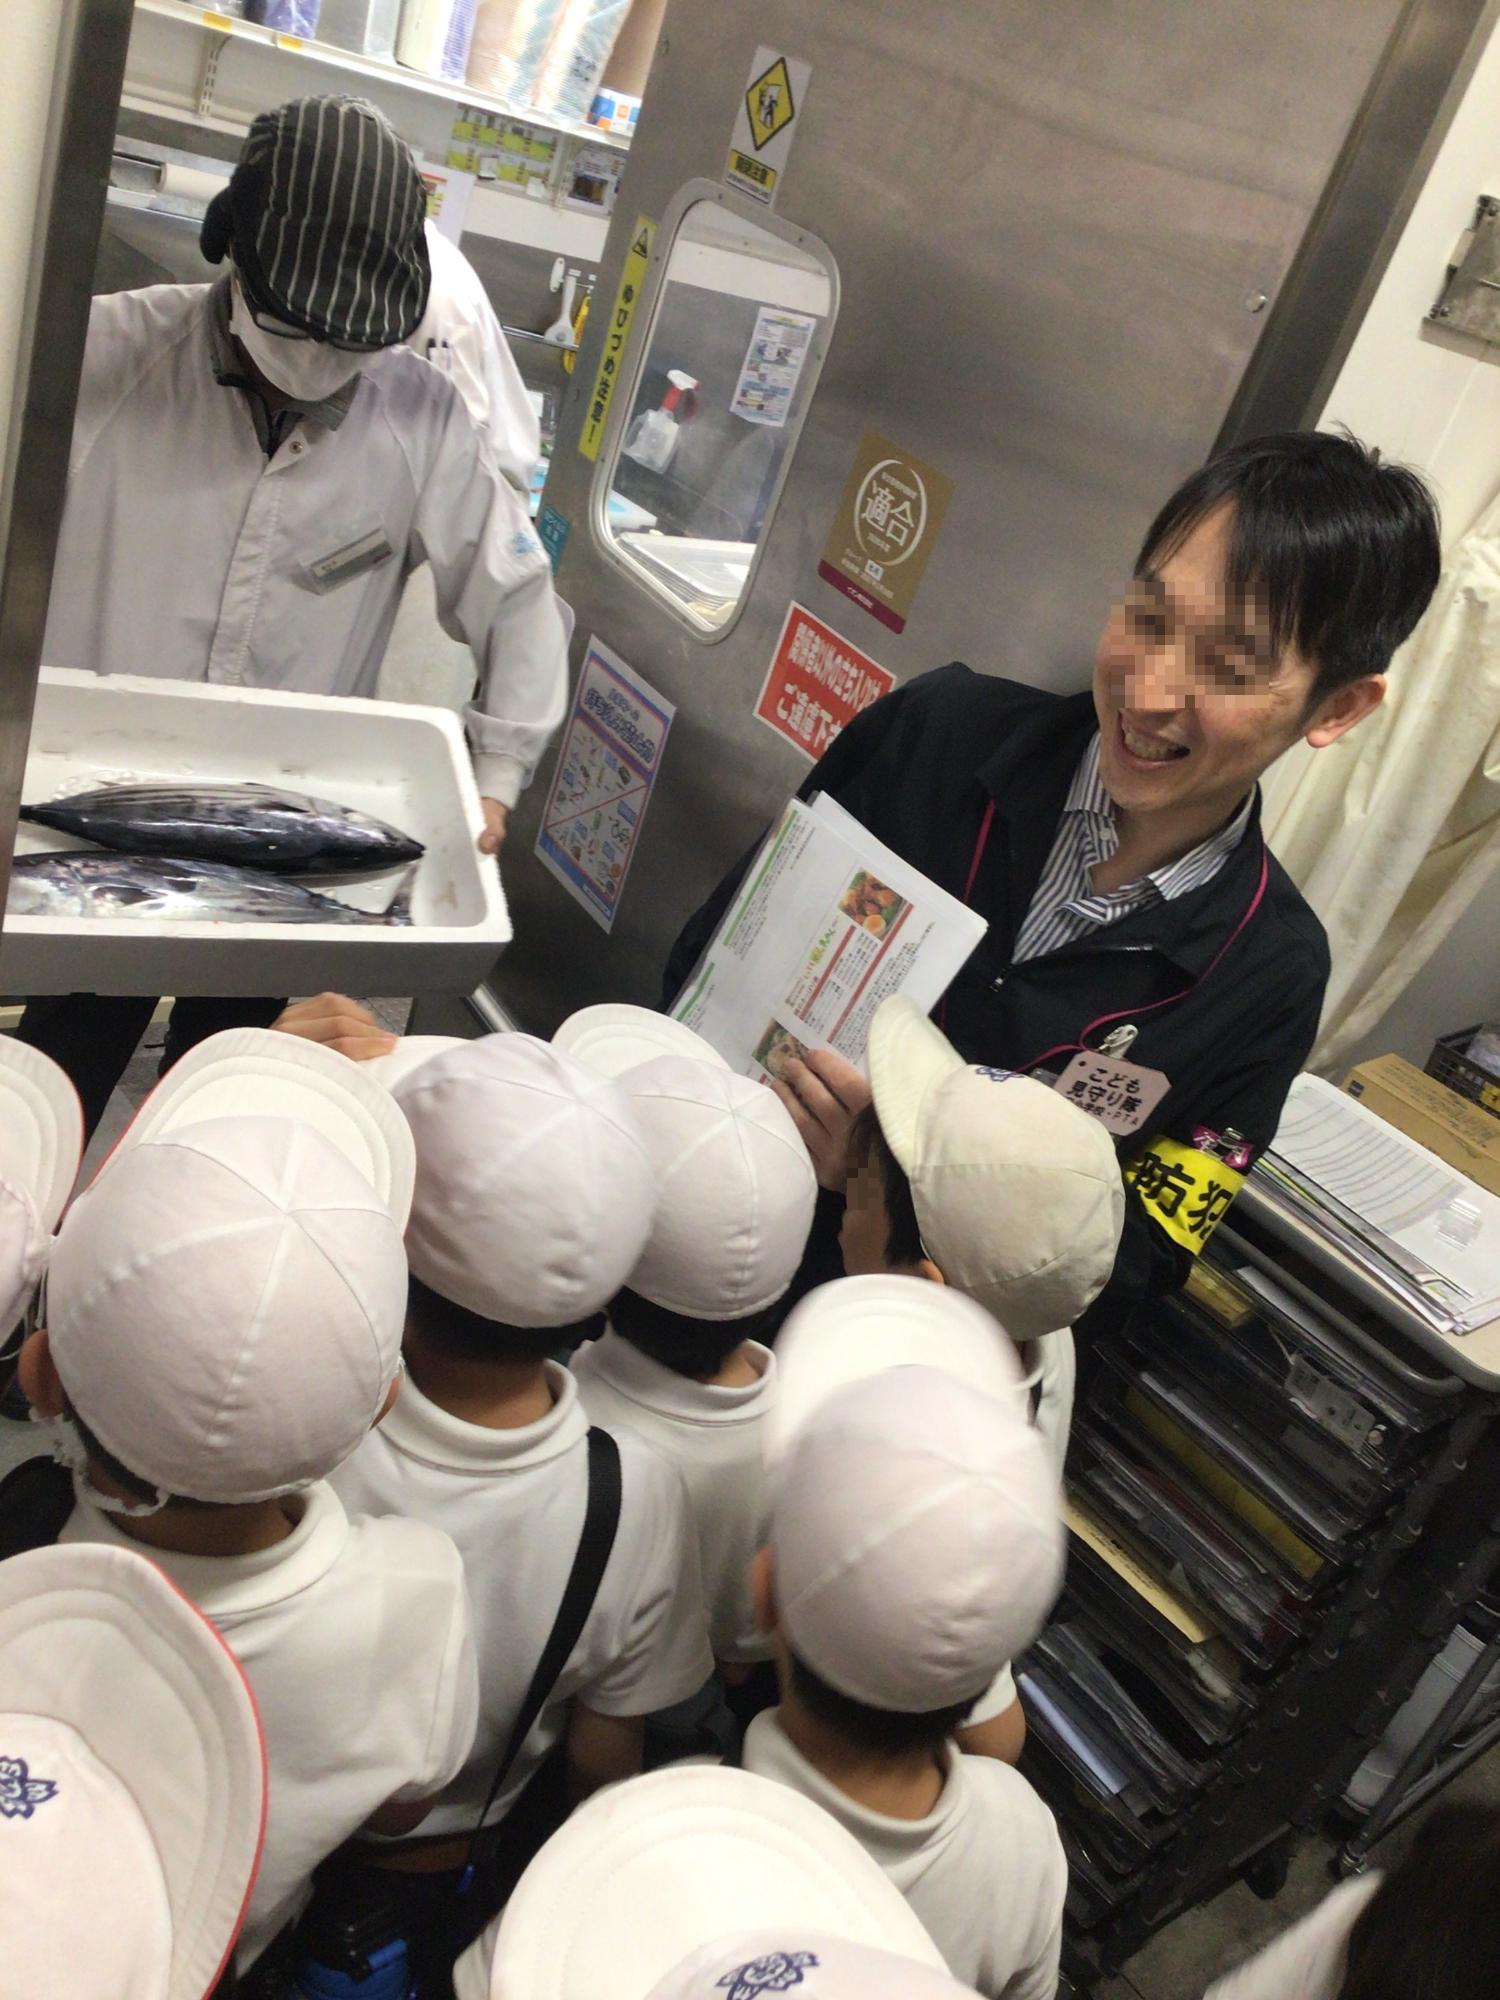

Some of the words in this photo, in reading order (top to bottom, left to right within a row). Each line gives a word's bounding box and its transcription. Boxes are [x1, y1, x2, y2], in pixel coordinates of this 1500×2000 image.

[861, 480, 915, 546] 適合
[1066, 1080, 1143, 1113] 見守り隊
[1089, 1067, 1141, 1094] こども
